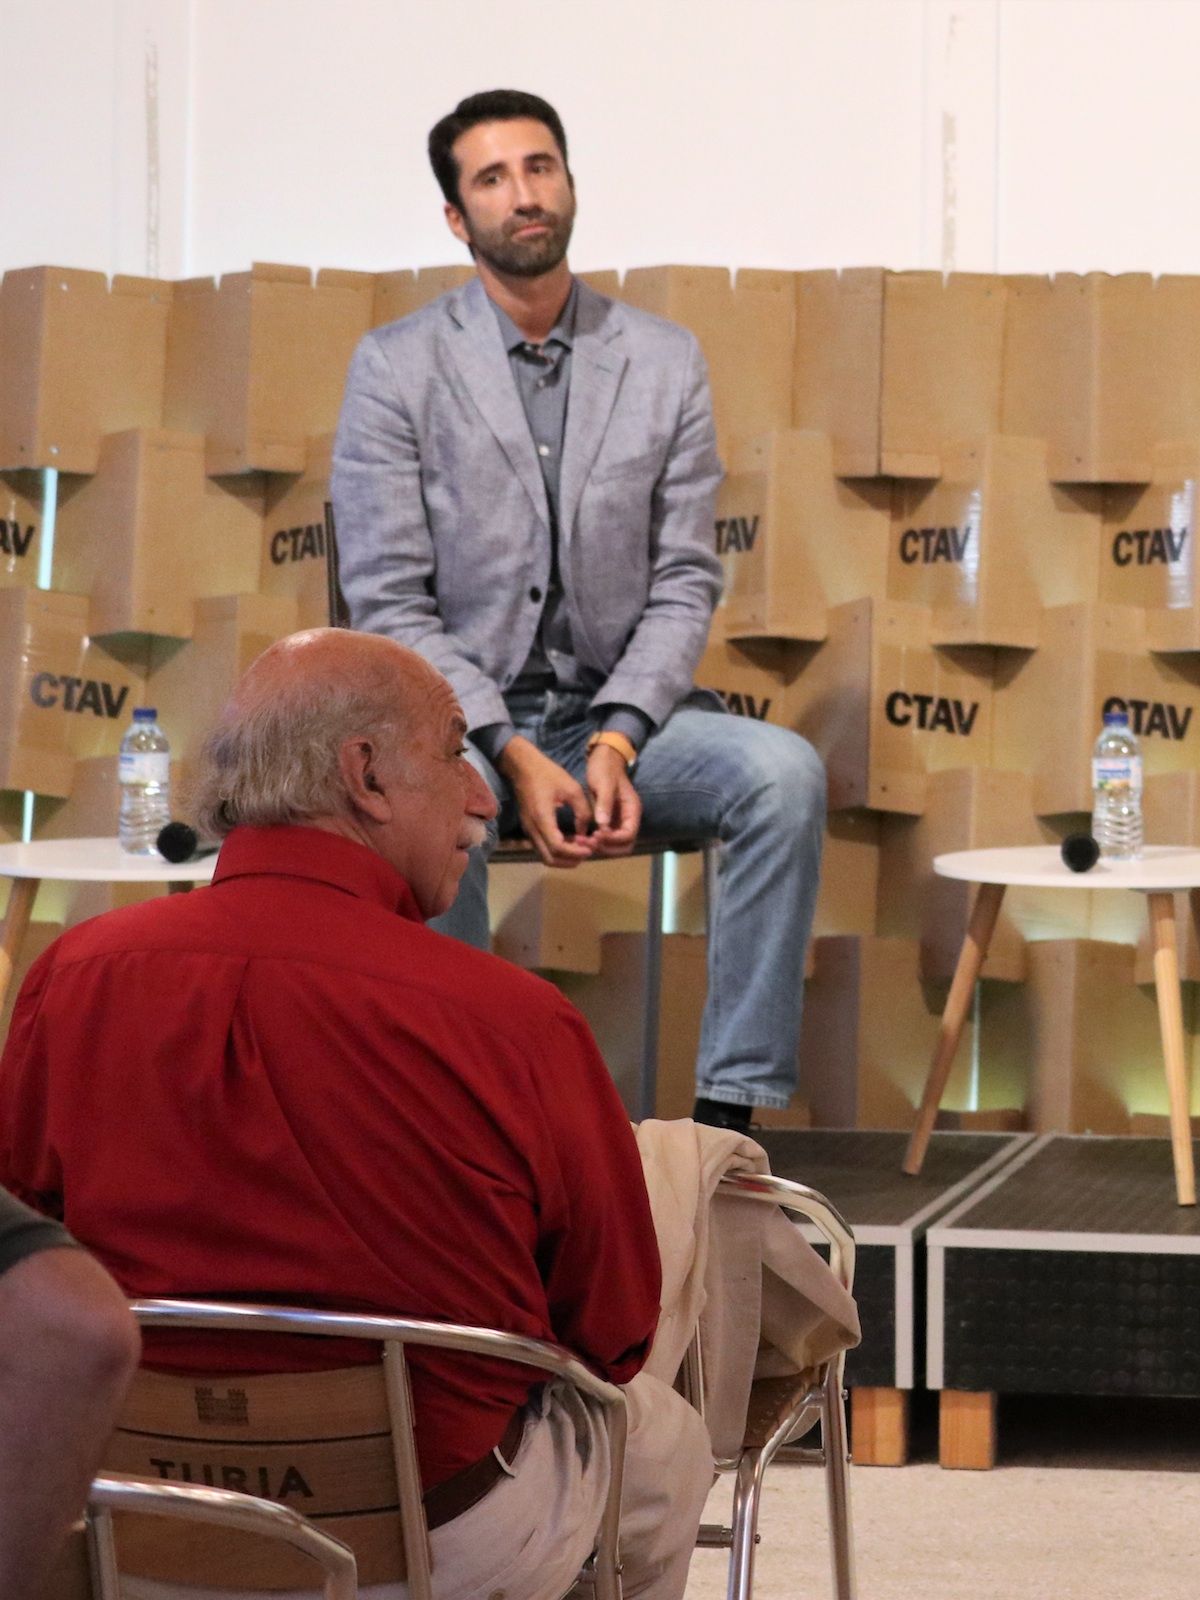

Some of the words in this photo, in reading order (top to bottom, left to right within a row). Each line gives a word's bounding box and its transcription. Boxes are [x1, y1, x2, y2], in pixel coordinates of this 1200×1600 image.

[900, 526, 972, 564] CTAV
[1112, 527, 1187, 567] CTAV
[30, 671, 129, 719] CTAV
[885, 690, 979, 736] CTAV
